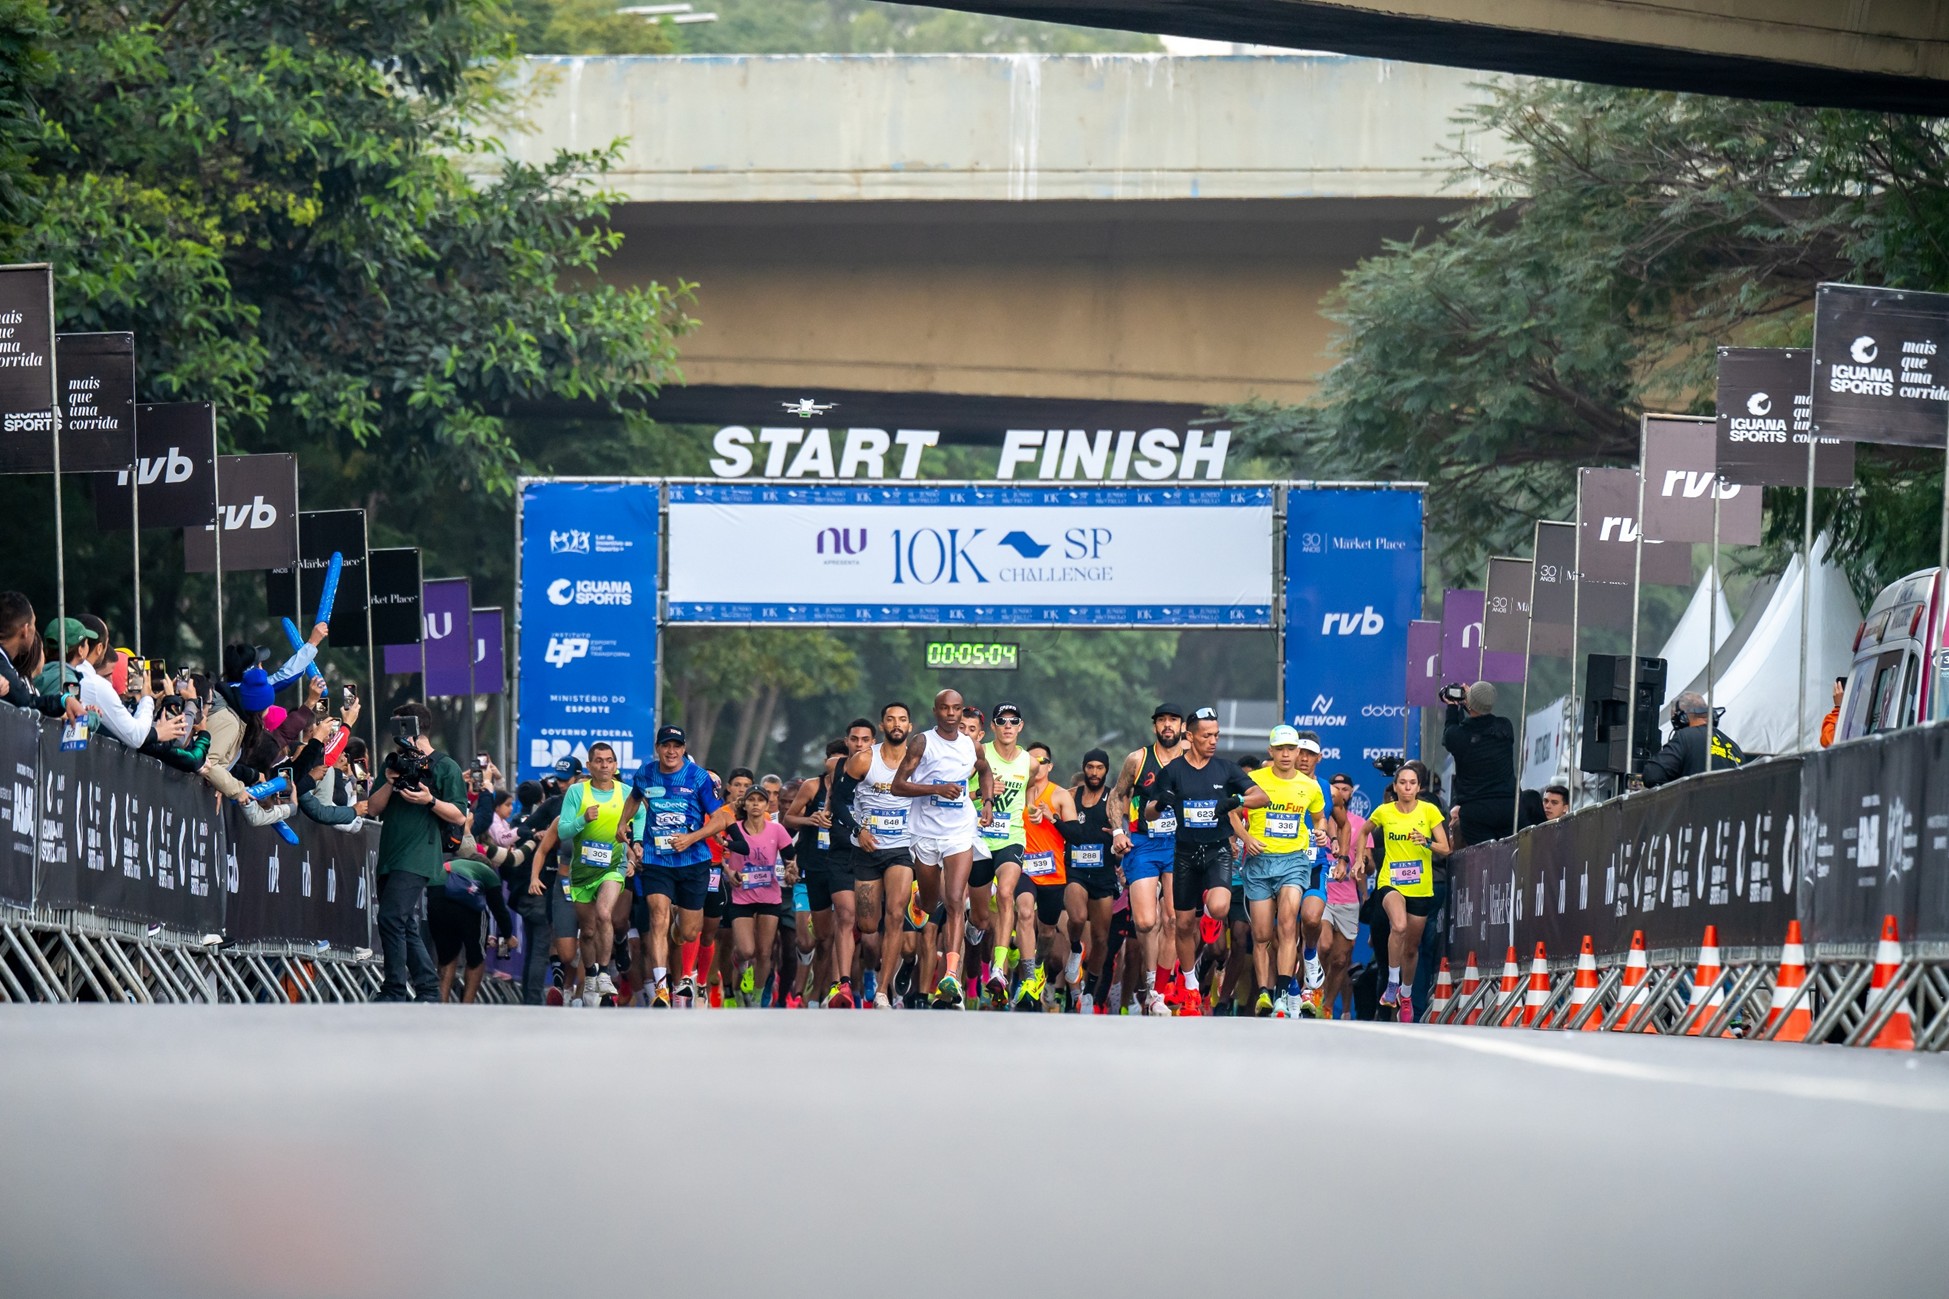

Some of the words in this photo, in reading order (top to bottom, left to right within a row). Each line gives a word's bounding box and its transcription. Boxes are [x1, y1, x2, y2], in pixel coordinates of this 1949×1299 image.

[0, 310, 23, 324] ais
[1902, 340, 1937, 355] mais
[0, 352, 42, 367] orrida
[1901, 356, 1928, 371] que
[1831, 364, 1894, 384] IGUANA
[1901, 371, 1932, 385] uma
[69, 376, 100, 390] mais
[1830, 378, 1894, 397] SPORTS
[69, 393, 92, 407] que
[69, 406, 98, 417] uma
[69, 416, 118, 430] corrida
[1730, 418, 1787, 431] IGUANA
[1730, 430, 1787, 443] SPORTS
[709, 426, 940, 478] START
[997, 428, 1232, 480] FINISH
[1302, 533, 1321, 547] 30
[1333, 537, 1371, 550] Market
[1375, 537, 1406, 550] Place
[891, 528, 991, 585] 10K
[1064, 528, 1112, 560] SP
[999, 567, 1113, 582] CHALLENGE
[1540, 565, 1557, 577] 30
[576, 580, 632, 593] IGUANA
[576, 593, 632, 606] SPORTS
[1492, 596, 1507, 608] 30
[1321, 605, 1384, 635] rvb
[550, 694, 609, 703] MINISTÉRIO
[611, 696, 626, 704] DO
[565, 706, 610, 714] ESPORTE
[1294, 715, 1347, 726] NEWON
[541, 728, 588, 736] GOVERNO
[591, 729, 634, 738] FEDERAL
[1197, 810, 1213, 818] 623
[592, 850, 608, 859] 305
[1401, 869, 1417, 877] 624
